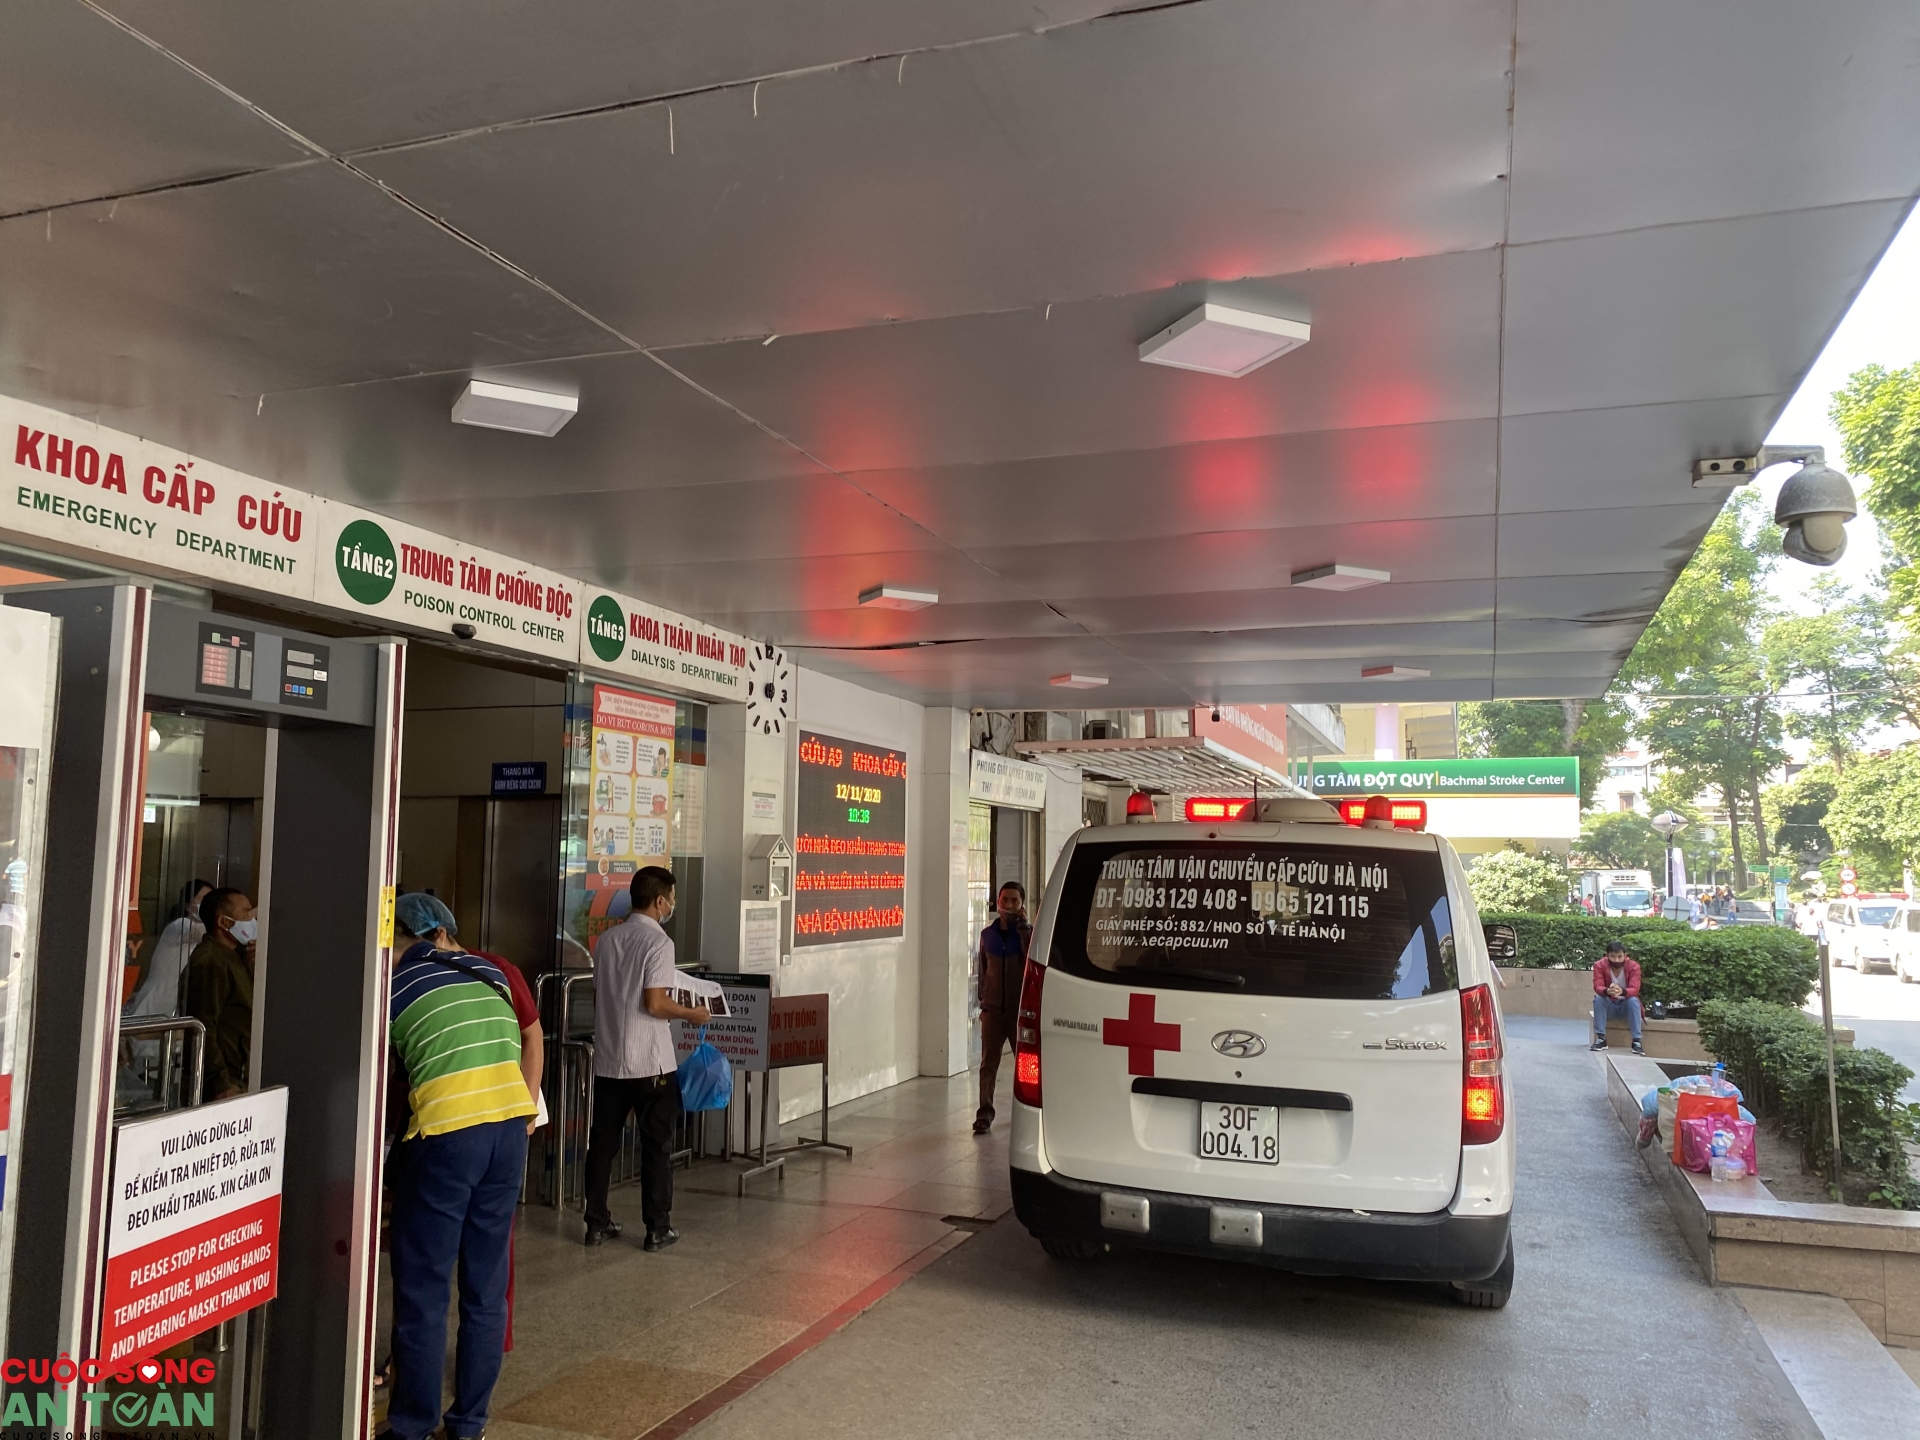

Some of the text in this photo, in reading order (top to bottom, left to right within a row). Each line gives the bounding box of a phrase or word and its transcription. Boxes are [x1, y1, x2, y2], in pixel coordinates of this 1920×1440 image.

[15, 424, 302, 543] KHOA CẤP CỨU
[17, 486, 296, 575] EMERGENCY DEPARTMENT
[342, 542, 394, 580] TẦNG2
[401, 543, 573, 621] TRUNG TÂM CHỐNG ĐỘC
[405, 590, 564, 643] POISON CONTROL CENTER
[630, 613, 746, 671] KHOA THẬN NHÂN TẠO
[765, 644, 774, 660] 12
[632, 649, 738, 687] DIALYSIS DEPARTMENT
[781, 690, 788, 703] 3
[596, 714, 673, 737] DO VI RÚT CORONA MỚI
[764, 720, 771, 735] 6
[502, 767, 522, 776] THANG
[828, 747, 843, 768] A9
[853, 752, 880, 775] KHOA
[882, 753, 900, 777] CẤP
[977, 759, 996, 774] PHÒNG
[836, 784, 881, 803] 12/11/2020
[1328, 772, 1361, 787] TÂM
[1363, 771, 1397, 790] ĐỘT
[1400, 773, 1435, 790] QUỴ
[1440, 776, 1487, 786] Bachmai
[1490, 775, 1525, 786] Stroke
[1527, 775, 1566, 785] Center
[1102, 859, 1145, 880] TRUNG
[1148, 855, 1176, 879] TÂM
[1179, 855, 1206, 883] VẬN
[1209, 853, 1265, 881] CHUYỂN
[1267, 857, 1297, 883] CẤP
[1298, 860, 1329, 885] CỨU
[1335, 862, 1356, 887] HÀ
[1169, 888, 1198, 909] 129
[1202, 888, 1238, 910] 408
[1252, 890, 1300, 913] 0965
[1304, 892, 1334, 916] 121
[1339, 895, 1369, 918] 115
[797, 909, 822, 934] NHÀ
[824, 908, 852, 936] BỆNH
[854, 906, 881, 930] NHÂN
[1096, 915, 1121, 931] GIẤY
[1123, 916, 1155, 931] PHÉP
[1269, 924, 1278, 936] Y
[1281, 920, 1300, 937] TẾ
[732, 993, 757, 1004] ĐOẠN
[710, 1022, 757, 1034] BẢO AN TOÀN
[783, 1011, 794, 1033] TỰ
[795, 1008, 817, 1029] ĐỘNG
[678, 1042, 693, 1051] ĐẾN
[740, 1046, 759, 1056] BỆNH
[683, 1032, 695, 1040] VUI
[696, 1033, 716, 1042] LNG
[716, 1034, 732, 1045] TẠM
[1385, 1038, 1448, 1051] Starex
[1219, 1105, 1260, 1132] 30F
[162, 1116, 253, 1158] VUI LÒNG DỪNG LẠI
[1203, 1131, 1276, 1160] 004.18
[125, 1137, 277, 1201] ĐỂ KIỂM TRA NHIỆT ĐỘ, RỬA TAY,
[128, 1166, 272, 1232] ĐEO KHẨU TRANG. XIN CẢM ƠN
[130, 1219, 263, 1289] PLEASE STOP FOR CHECKING
[114, 1243, 272, 1328] TEMPERATURE, WASHING HANDS
[110, 1271, 271, 1363] AND WEARING MASK! THANK YOU
